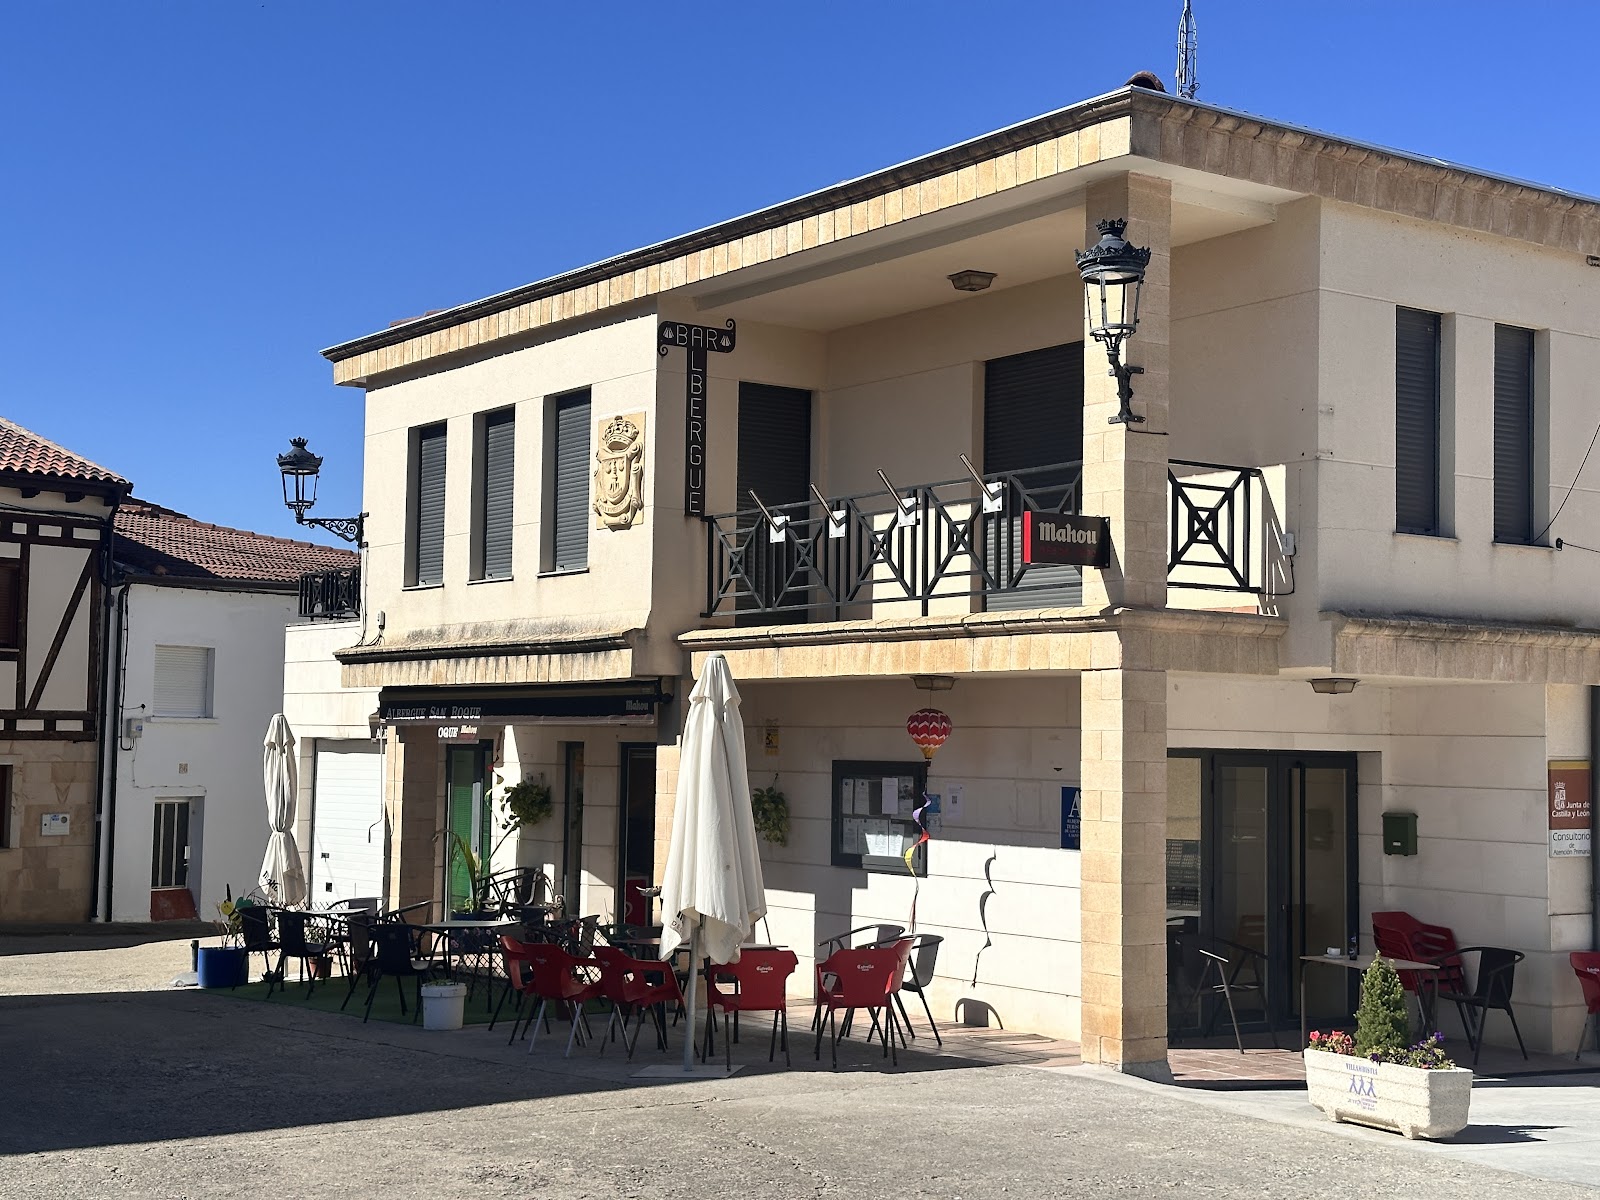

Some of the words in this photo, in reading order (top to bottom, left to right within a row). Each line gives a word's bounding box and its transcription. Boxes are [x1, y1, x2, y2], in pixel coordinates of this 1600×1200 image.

[676, 325, 718, 350] BAR
[1038, 522, 1098, 545] Mahou
[450, 705, 481, 718] ROQUE
[625, 699, 649, 711] Mahou
[437, 726, 459, 738] OQUE
[1068, 790, 1081, 818] A
[1553, 833, 1591, 841] Consultorio
